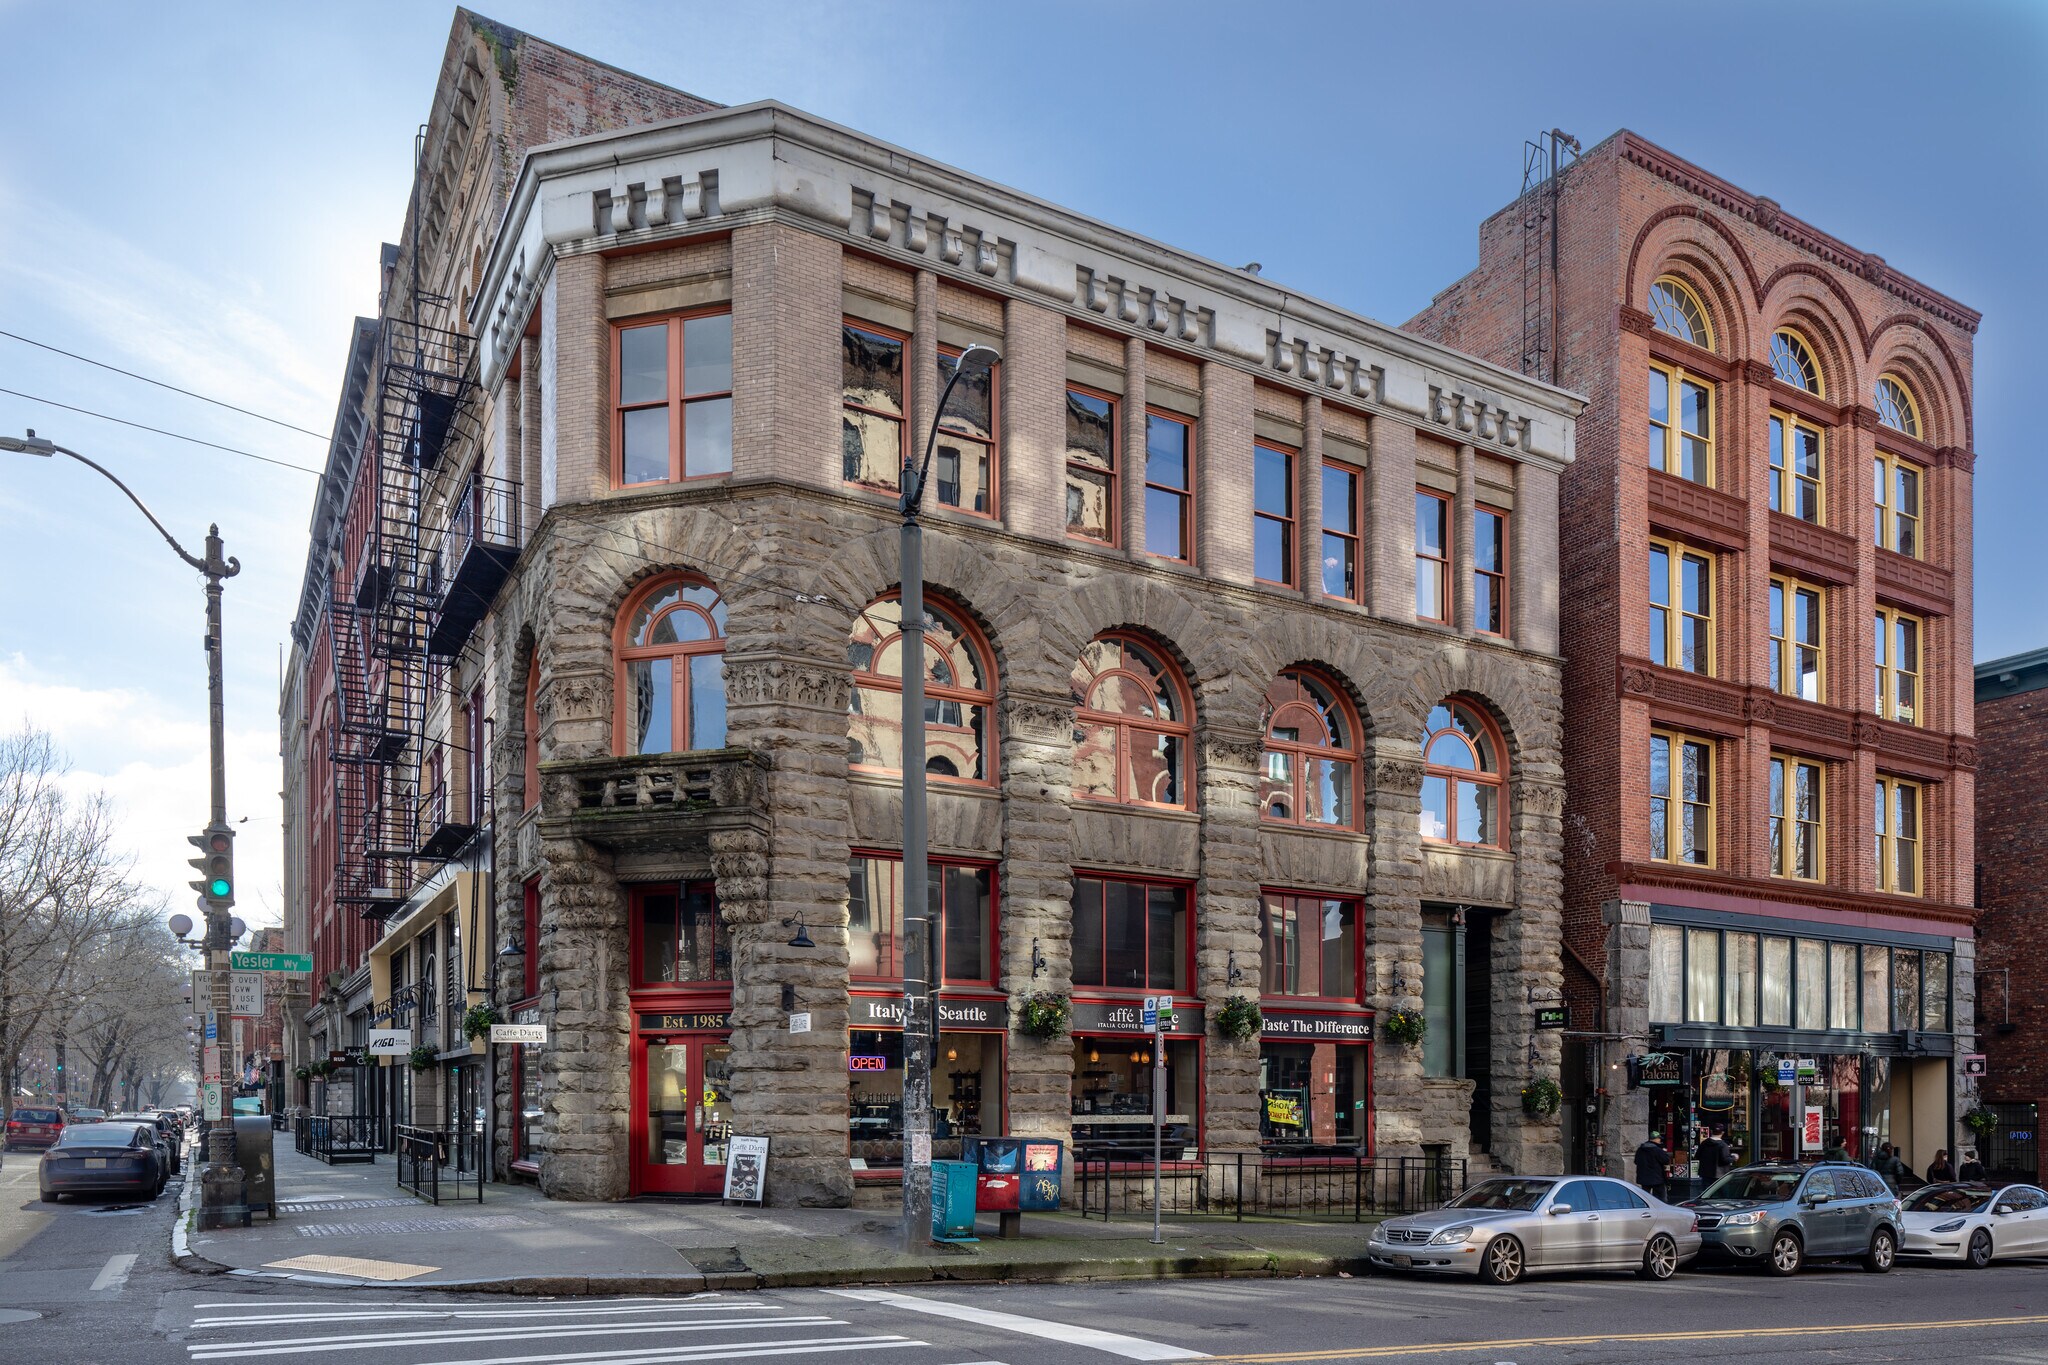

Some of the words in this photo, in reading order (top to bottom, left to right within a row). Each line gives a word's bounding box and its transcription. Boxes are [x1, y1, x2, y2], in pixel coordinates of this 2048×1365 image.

[235, 954, 276, 968] Yesler
[284, 960, 298, 970] Wy
[869, 1003, 904, 1023] Italy
[938, 1005, 987, 1021] Seattle
[663, 1015, 688, 1028] Est.
[692, 1015, 724, 1028] 1985
[1261, 1019, 1289, 1031] Taste
[1291, 1019, 1313, 1032] The
[1315, 1020, 1370, 1034] Difference
[851, 1058, 884, 1070] OPEN
[1642, 1069, 1680, 1080] Paloma
